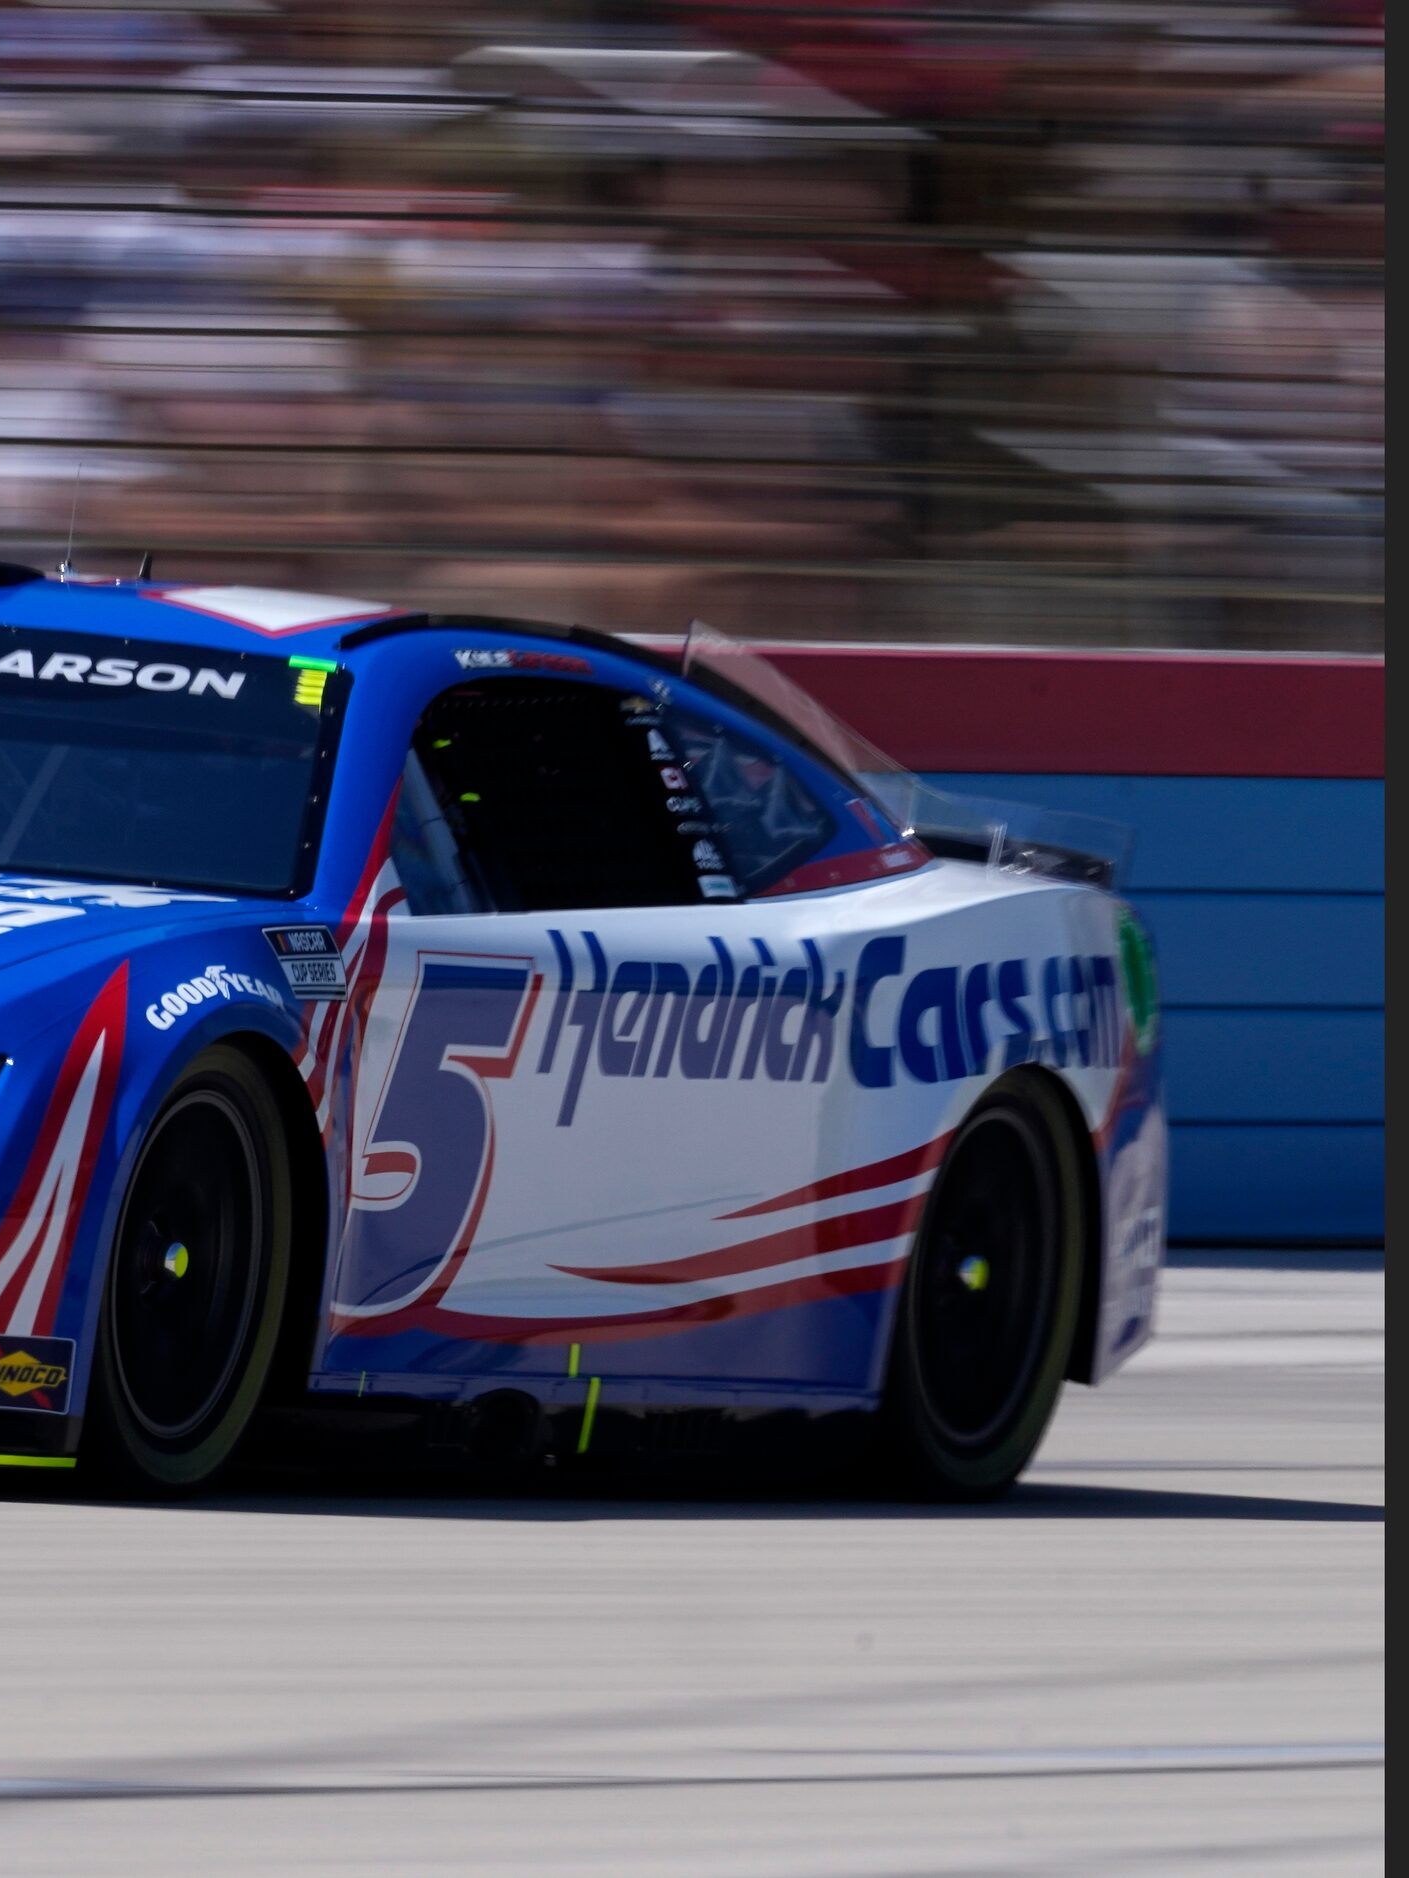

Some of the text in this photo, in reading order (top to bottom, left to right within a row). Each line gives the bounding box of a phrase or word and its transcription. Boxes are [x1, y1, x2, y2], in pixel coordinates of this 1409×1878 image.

[288, 931, 327, 952] NASCAR
[291, 961, 337, 983] CUP SERIES
[146, 964, 286, 1031] GOODYEAR
[331, 950, 544, 1335] 5
